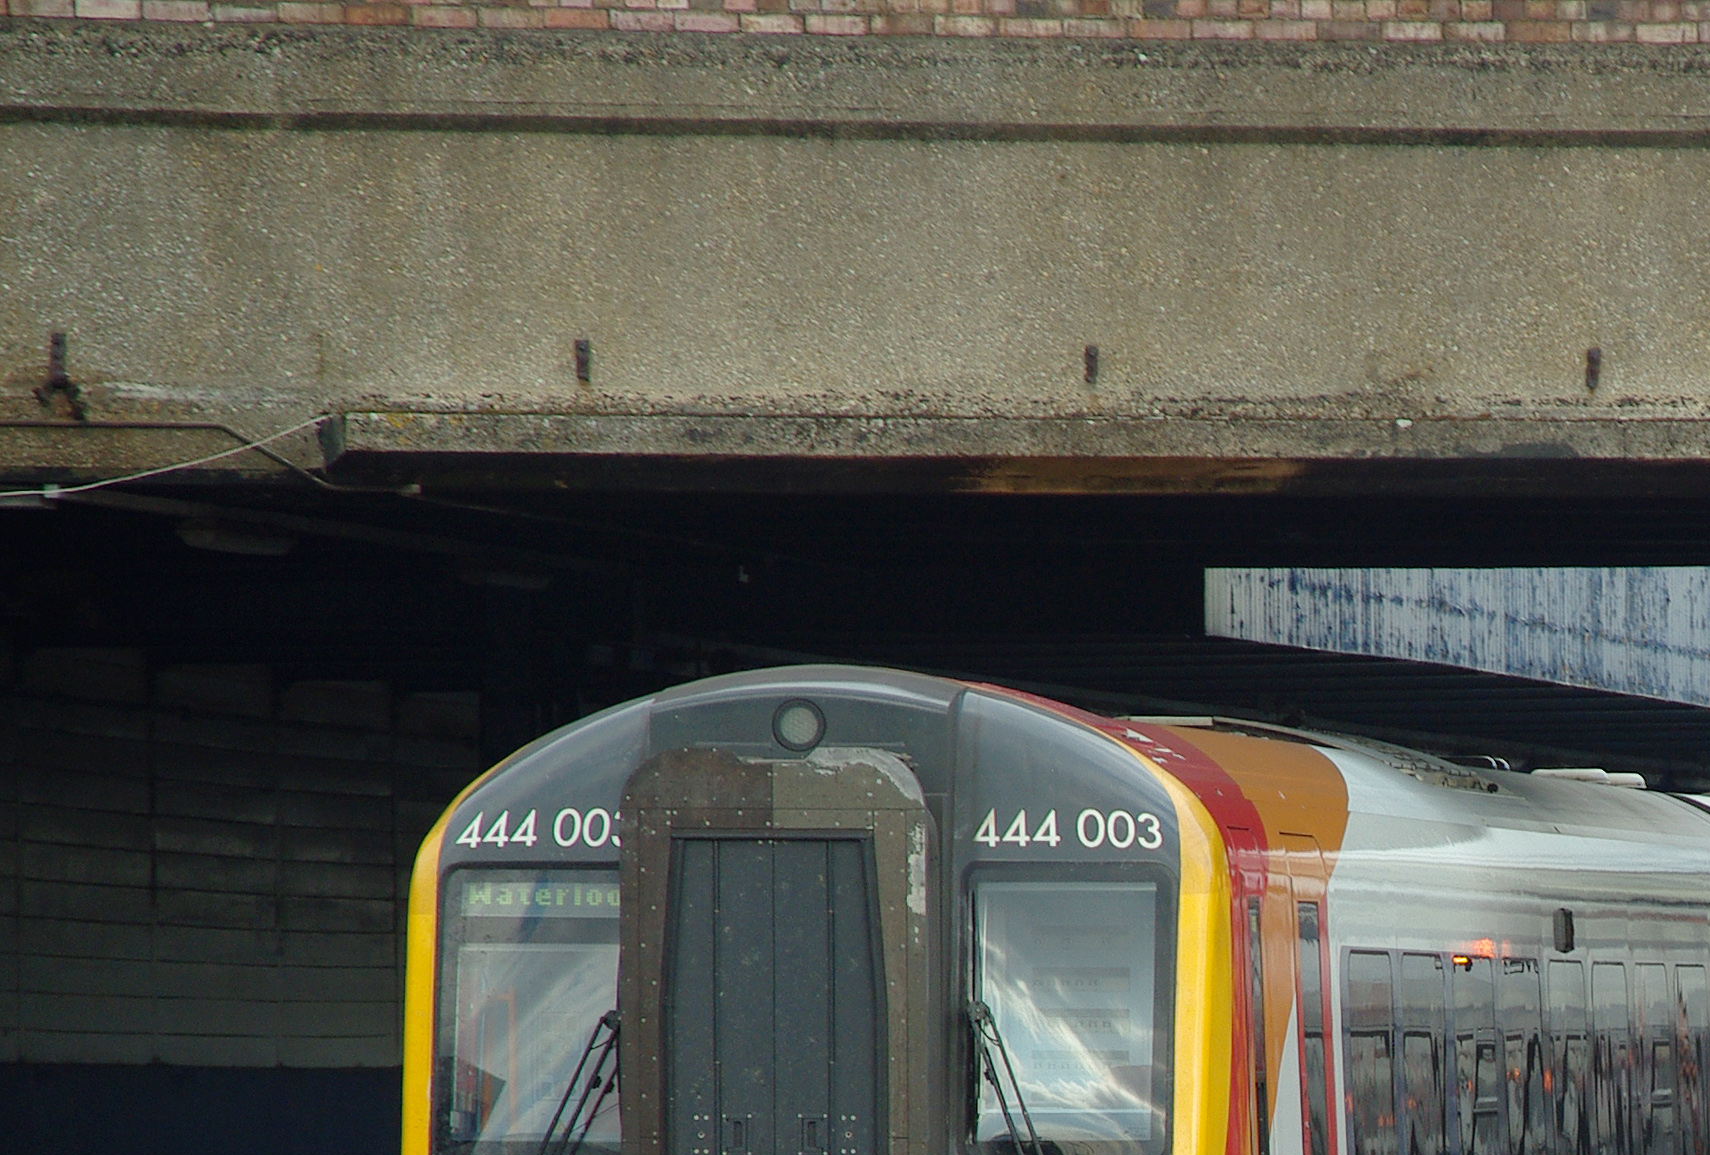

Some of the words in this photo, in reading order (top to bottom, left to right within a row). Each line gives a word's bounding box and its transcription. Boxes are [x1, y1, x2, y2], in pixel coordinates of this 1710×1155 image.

[455, 809, 538, 849] 444
[973, 807, 1062, 848] 444
[1075, 807, 1164, 850] 003
